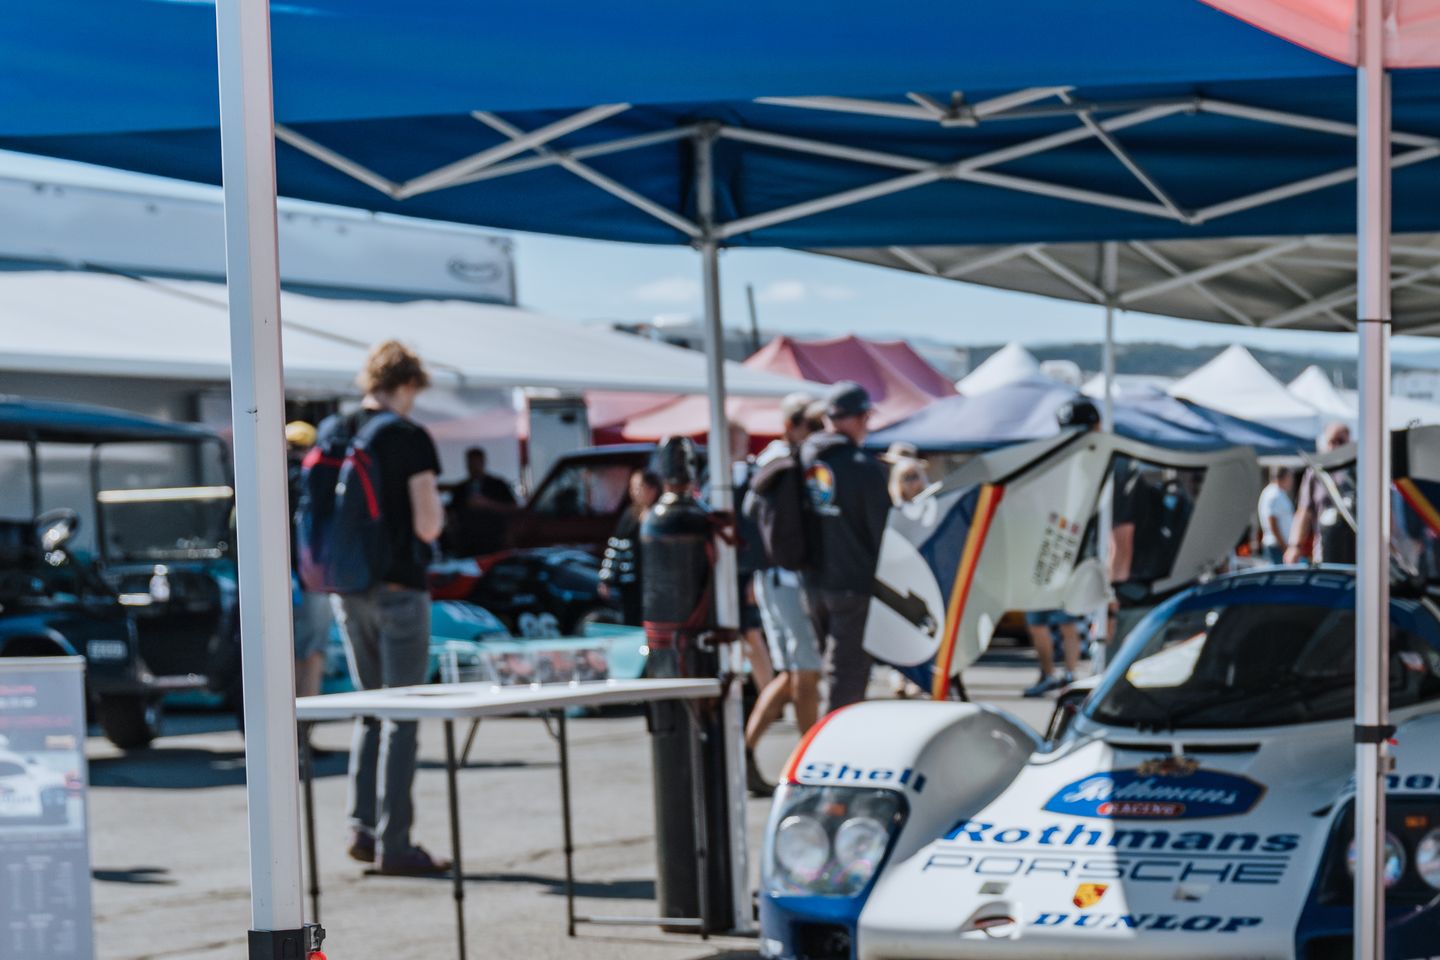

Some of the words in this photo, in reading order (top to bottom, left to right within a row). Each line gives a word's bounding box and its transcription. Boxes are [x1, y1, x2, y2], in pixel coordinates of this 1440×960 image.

[802, 763, 926, 793] Shell
[1062, 777, 1236, 804] Rothmans
[943, 819, 1301, 852] Rothmans
[922, 854, 1288, 884] PORSCHE
[1031, 912, 1263, 932] DUNLOP
